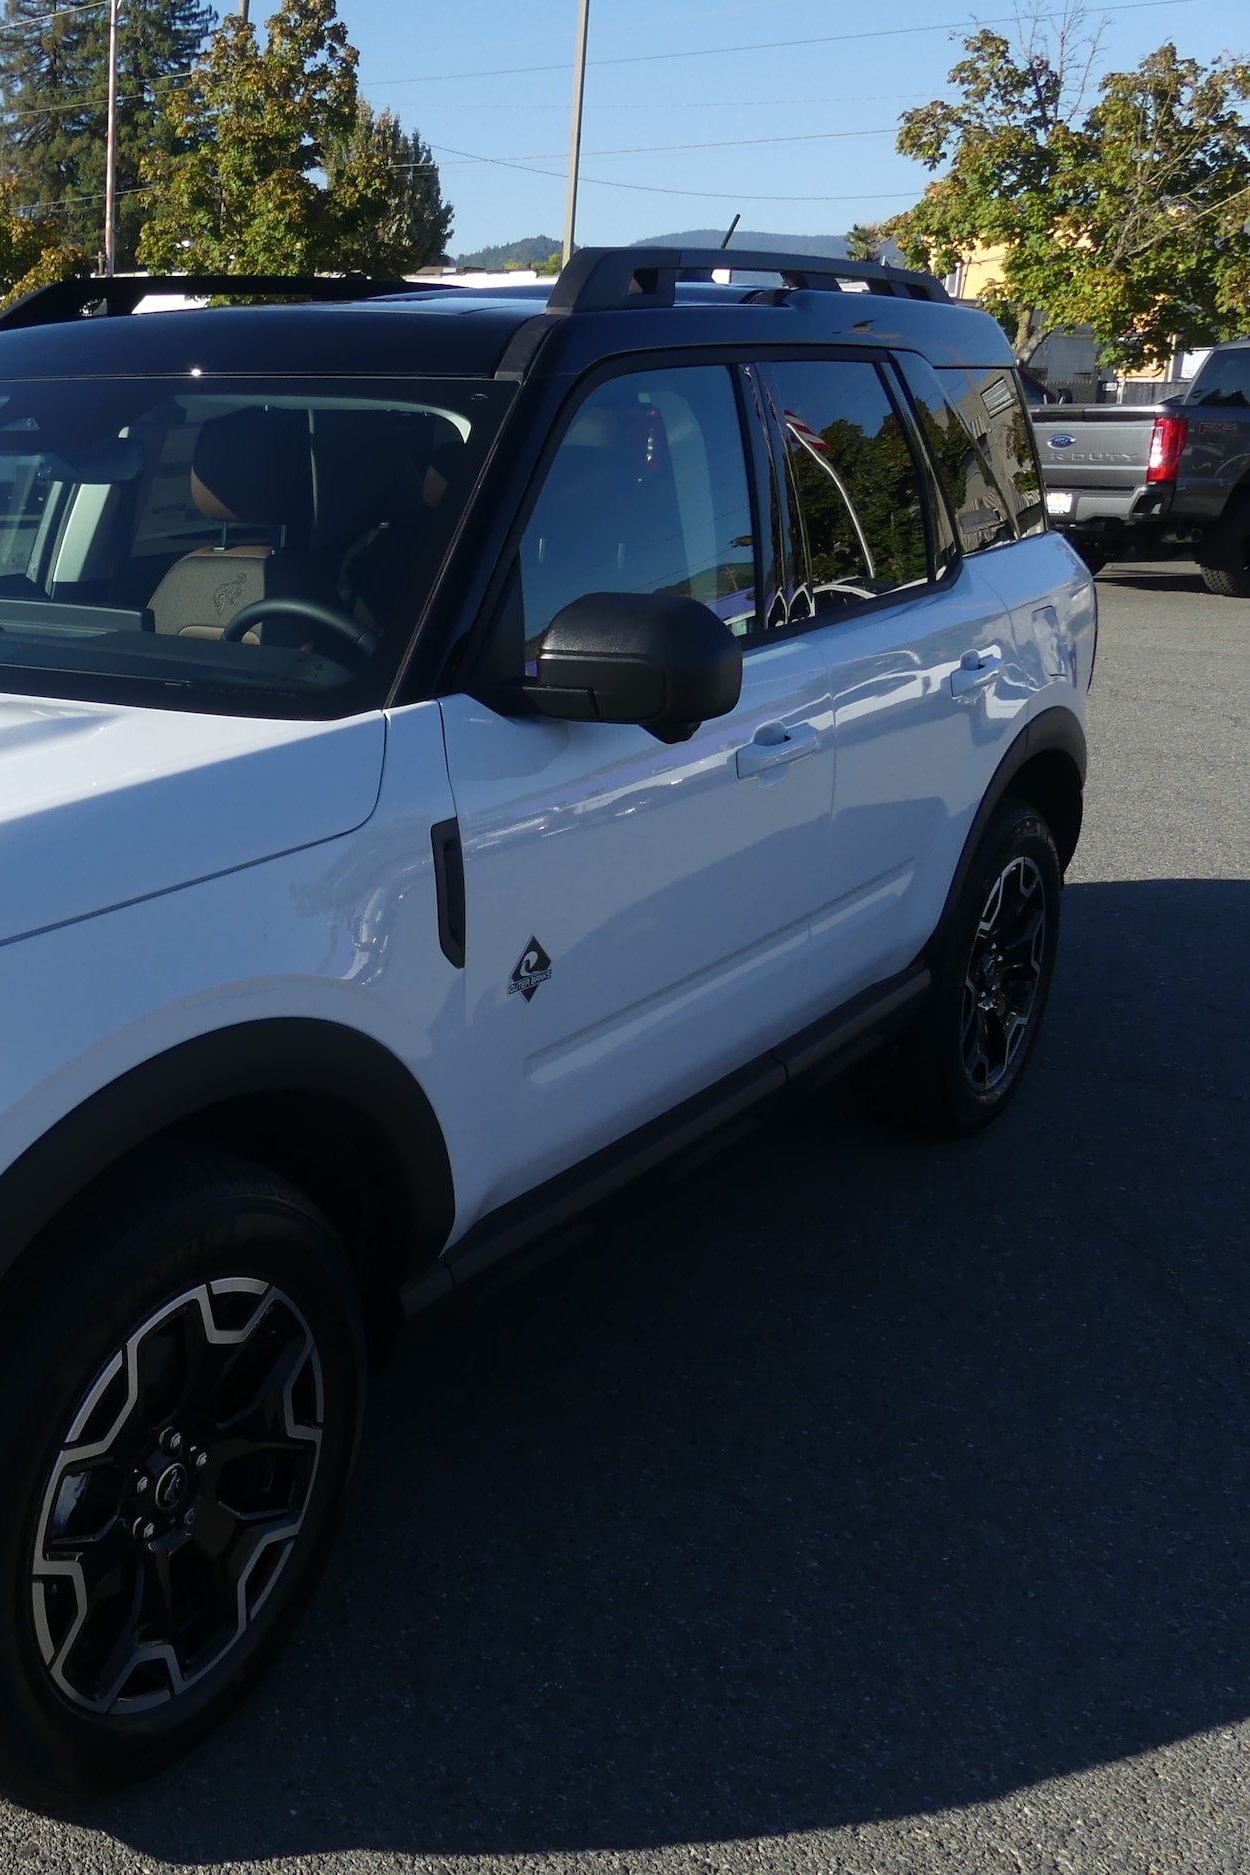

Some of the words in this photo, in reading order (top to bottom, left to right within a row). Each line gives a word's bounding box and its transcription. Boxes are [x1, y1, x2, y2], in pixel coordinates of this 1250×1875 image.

[1199, 422, 1237, 433] FX4
[1071, 452, 1138, 462] DUTY
[509, 979, 530, 993] OUTER
[530, 971, 551, 985] BANKS
